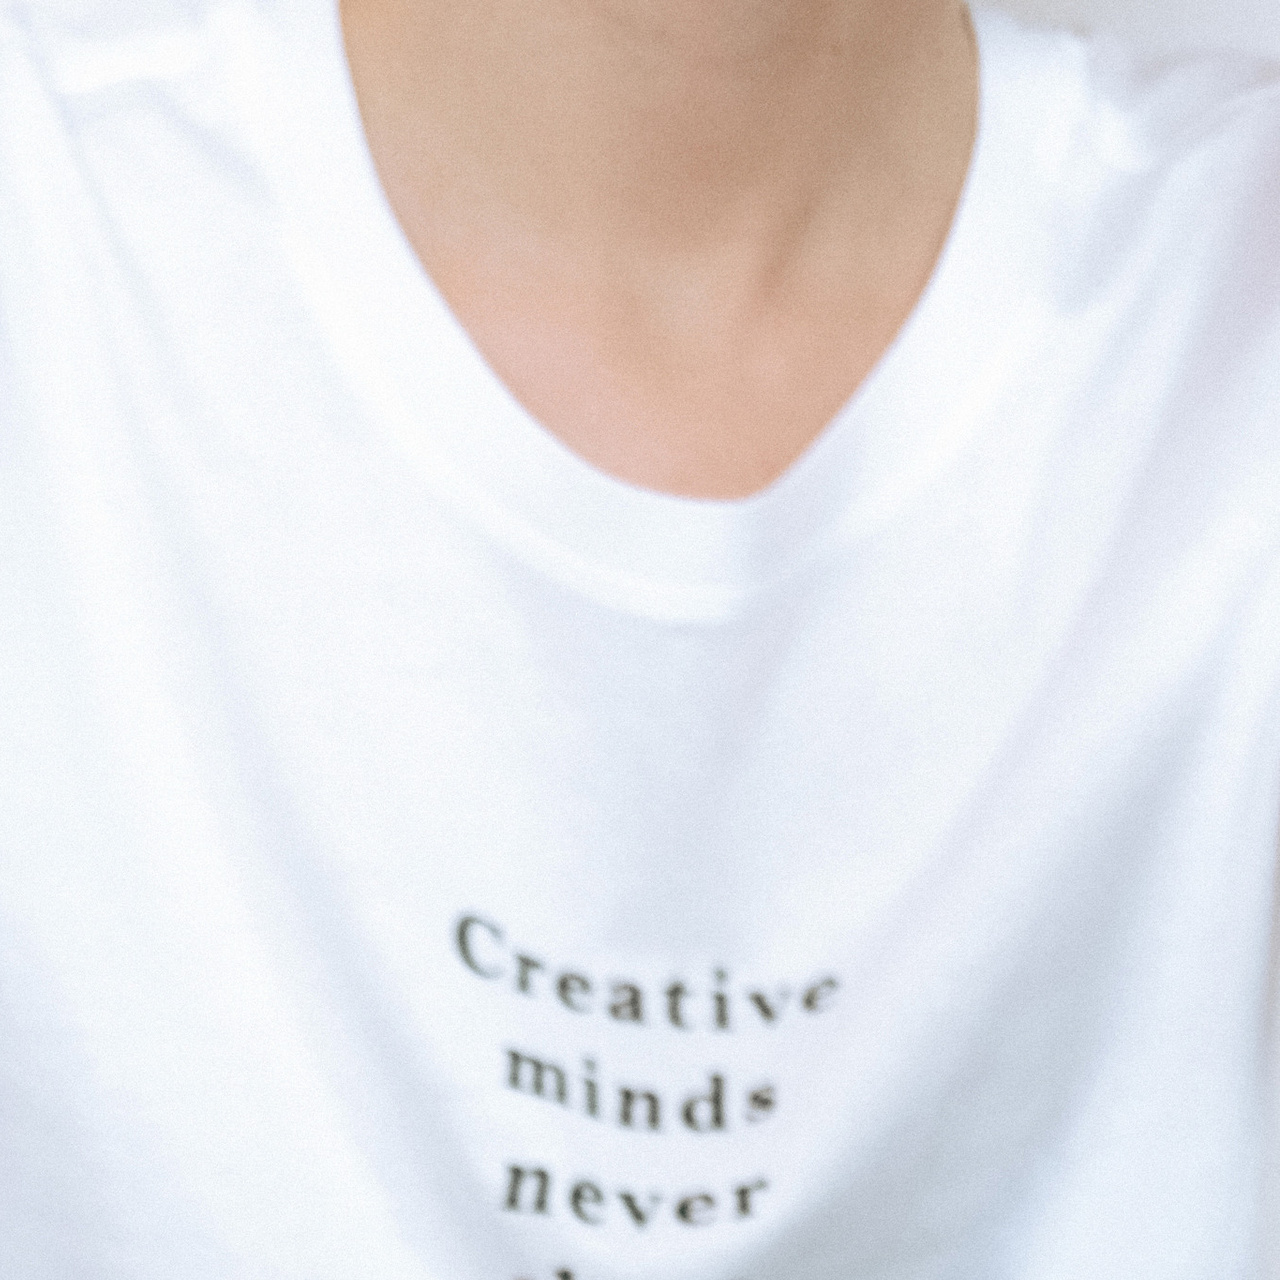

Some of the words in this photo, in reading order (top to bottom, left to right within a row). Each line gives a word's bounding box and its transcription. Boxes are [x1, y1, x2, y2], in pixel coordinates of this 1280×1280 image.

[452, 914, 839, 1030] Creative
[505, 1048, 776, 1132] minds
[504, 1163, 768, 1227] never
